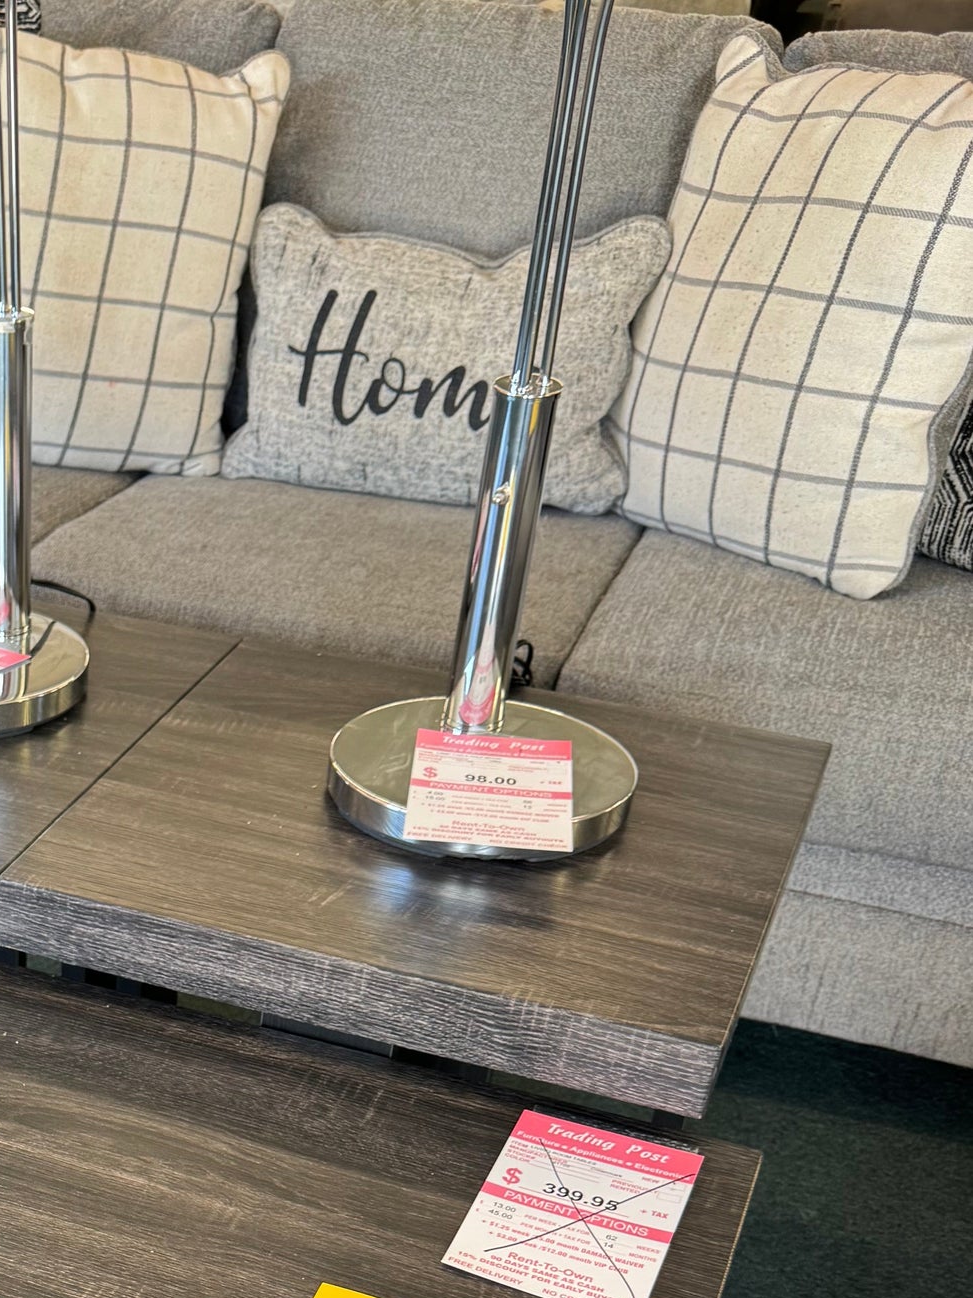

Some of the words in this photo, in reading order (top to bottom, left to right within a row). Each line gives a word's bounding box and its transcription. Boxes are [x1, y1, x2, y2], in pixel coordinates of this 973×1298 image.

[288, 289, 490, 431] Hom
[443, 736, 499, 749] Trading
[423, 766, 438, 779] $
[465, 774, 517, 785] 98.00
[429, 782, 489, 792] PAYMENT
[493, 787, 553, 798] OPTIONS
[548, 1123, 615, 1151] Trading
[626, 1144, 669, 1163] Post
[569, 1146, 623, 1164] Appliances
[494, 1202, 517, 1213] 13.00
[502, 1168, 523, 1185] $
[542, 1183, 619, 1211] 399.95
[652, 1210, 668, 1219] TAX
[504, 1190, 575, 1218] PAYMENT
[488, 1209, 513, 1220] 45.00
[448, 1256, 473, 1269] FREE
[475, 1266, 524, 1286] DELIVERY
[479, 1257, 528, 1278] DISCOUNT
[531, 1275, 551, 1284] FOR
[553, 1281, 584, 1293] EARLY
[504, 1259, 529, 1270] DAYS
[532, 1268, 559, 1280] SAME
[577, 1282, 604, 1293] CASH
[508, 1251, 594, 1283] Rent-To-Own
[542, 1288, 557, 1297] NO
